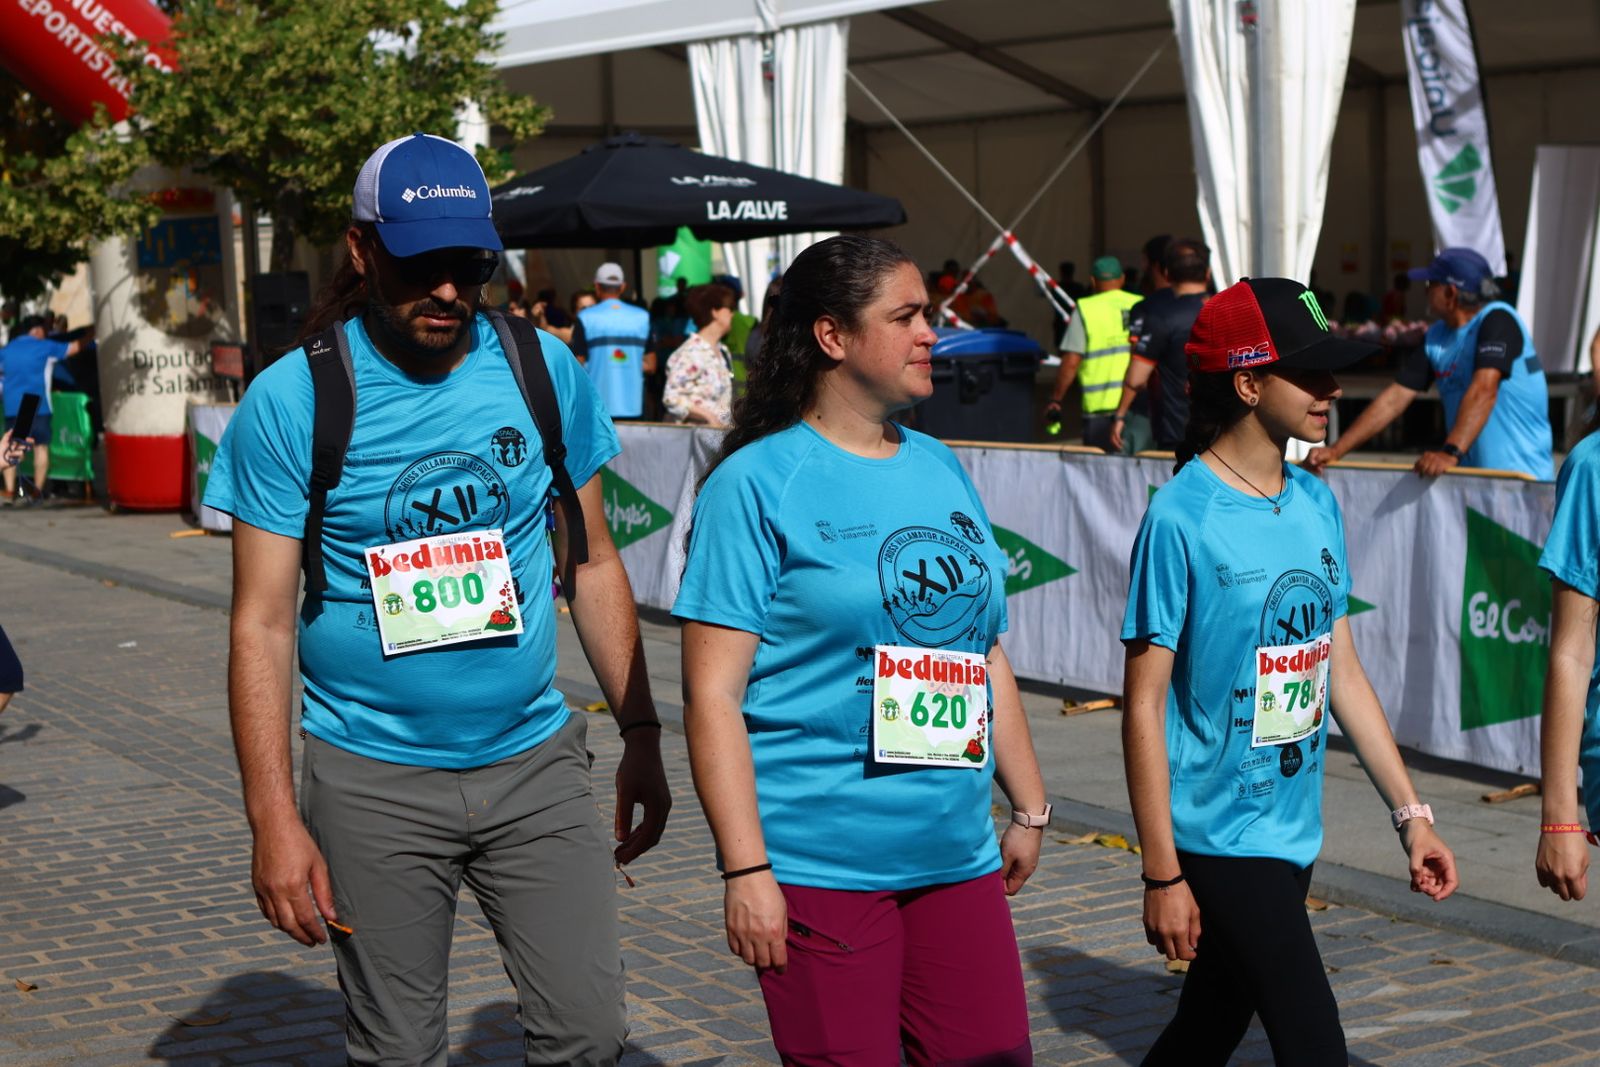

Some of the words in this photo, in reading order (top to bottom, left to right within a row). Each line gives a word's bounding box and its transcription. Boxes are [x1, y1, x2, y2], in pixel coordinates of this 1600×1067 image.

[416, 184, 477, 200] Columbia
[706, 200, 733, 221] LA
[732, 200, 788, 221] SALVE
[132, 350, 214, 373] Diputac
[398, 473, 420, 493] CROSS
[418, 456, 468, 477] VILLAMAYOR
[466, 459, 495, 483] ASPACE
[411, 484, 478, 531] XII
[369, 537, 504, 578] bedunia
[884, 539, 900, 563] CROSS
[896, 531, 937, 549] VILLAMAYOR
[939, 535, 970, 554] ASPACE
[412, 572, 485, 613] 800
[902, 555, 964, 601] XII
[1269, 588, 1282, 611] CROSS
[1280, 575, 1310, 591] VILLAMAYOR
[1310, 578, 1328, 600] ASPACE
[1468, 591, 1500, 639] El
[878, 651, 986, 686] bedunia
[910, 692, 967, 729] 620
